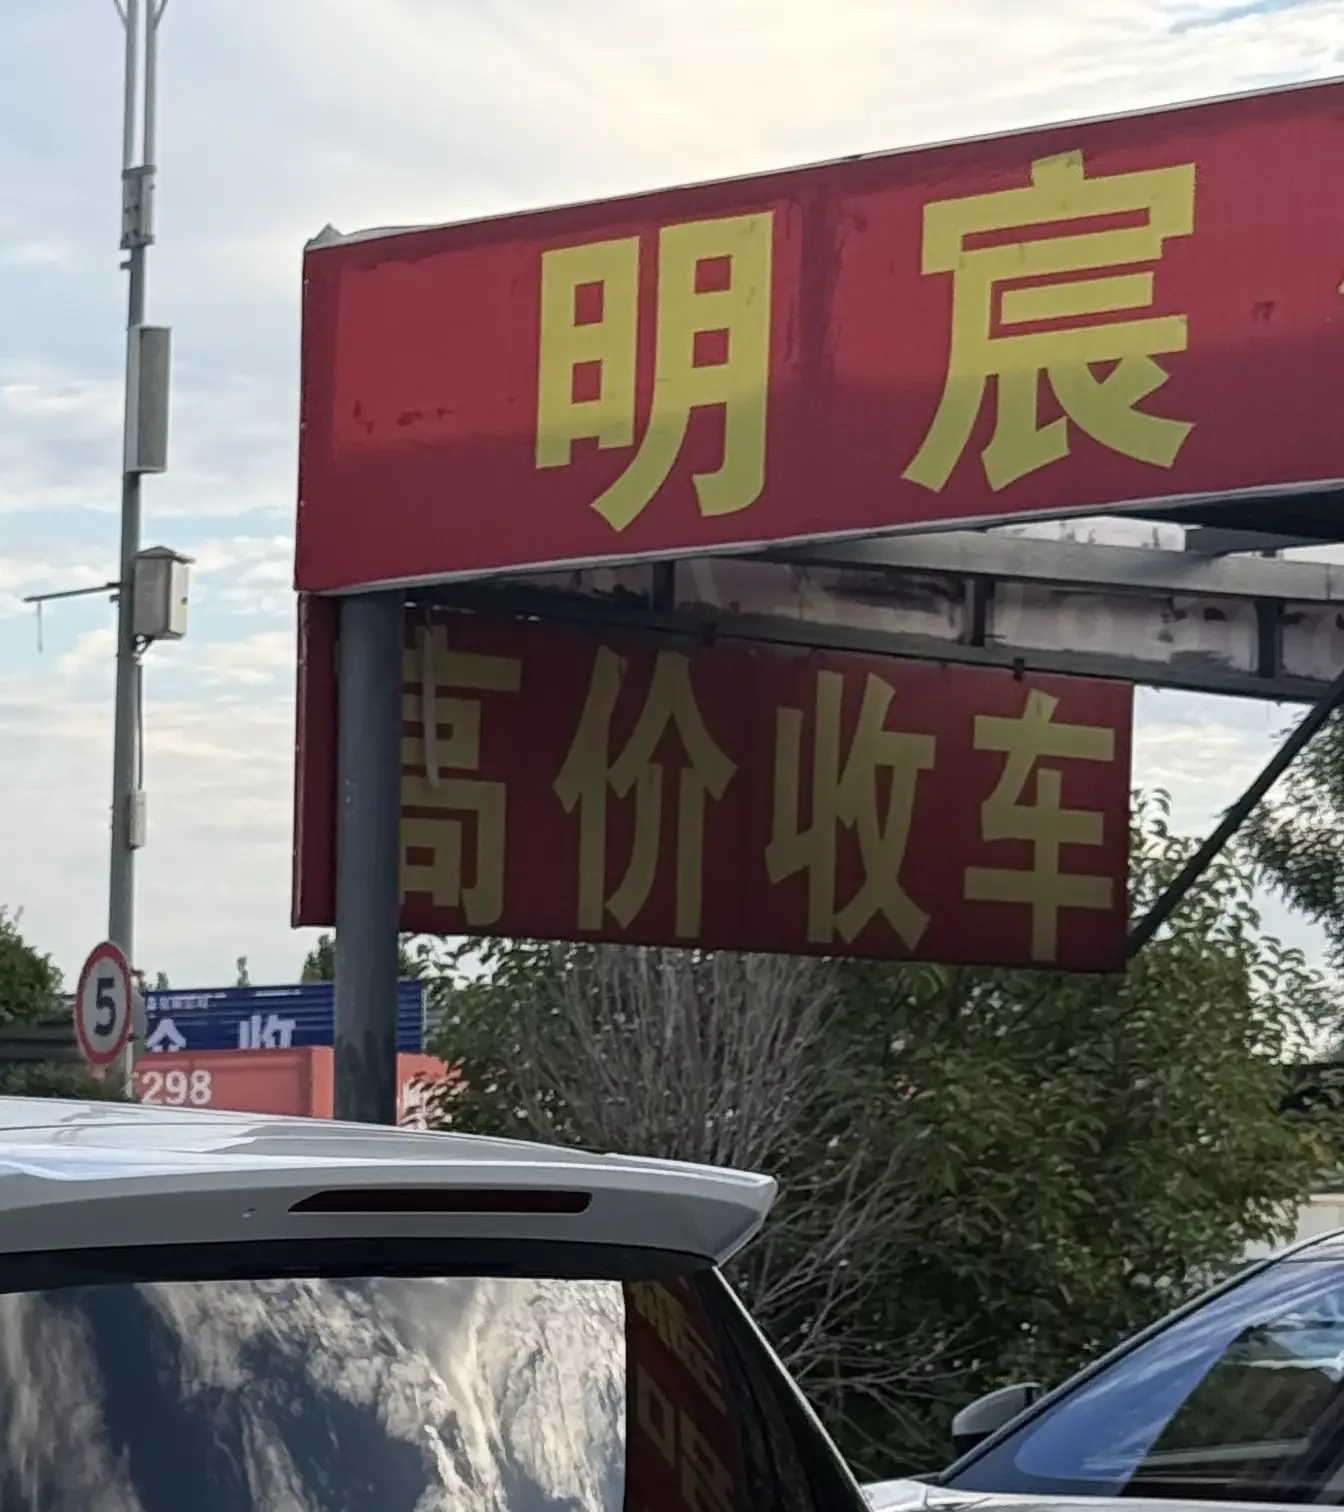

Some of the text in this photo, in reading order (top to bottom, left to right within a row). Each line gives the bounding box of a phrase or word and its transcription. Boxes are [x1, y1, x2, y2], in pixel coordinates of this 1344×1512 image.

[534, 149, 1196, 532] 明宸
[400, 624, 1115, 962] 高价收车
[94, 976, 117, 1036] 5
